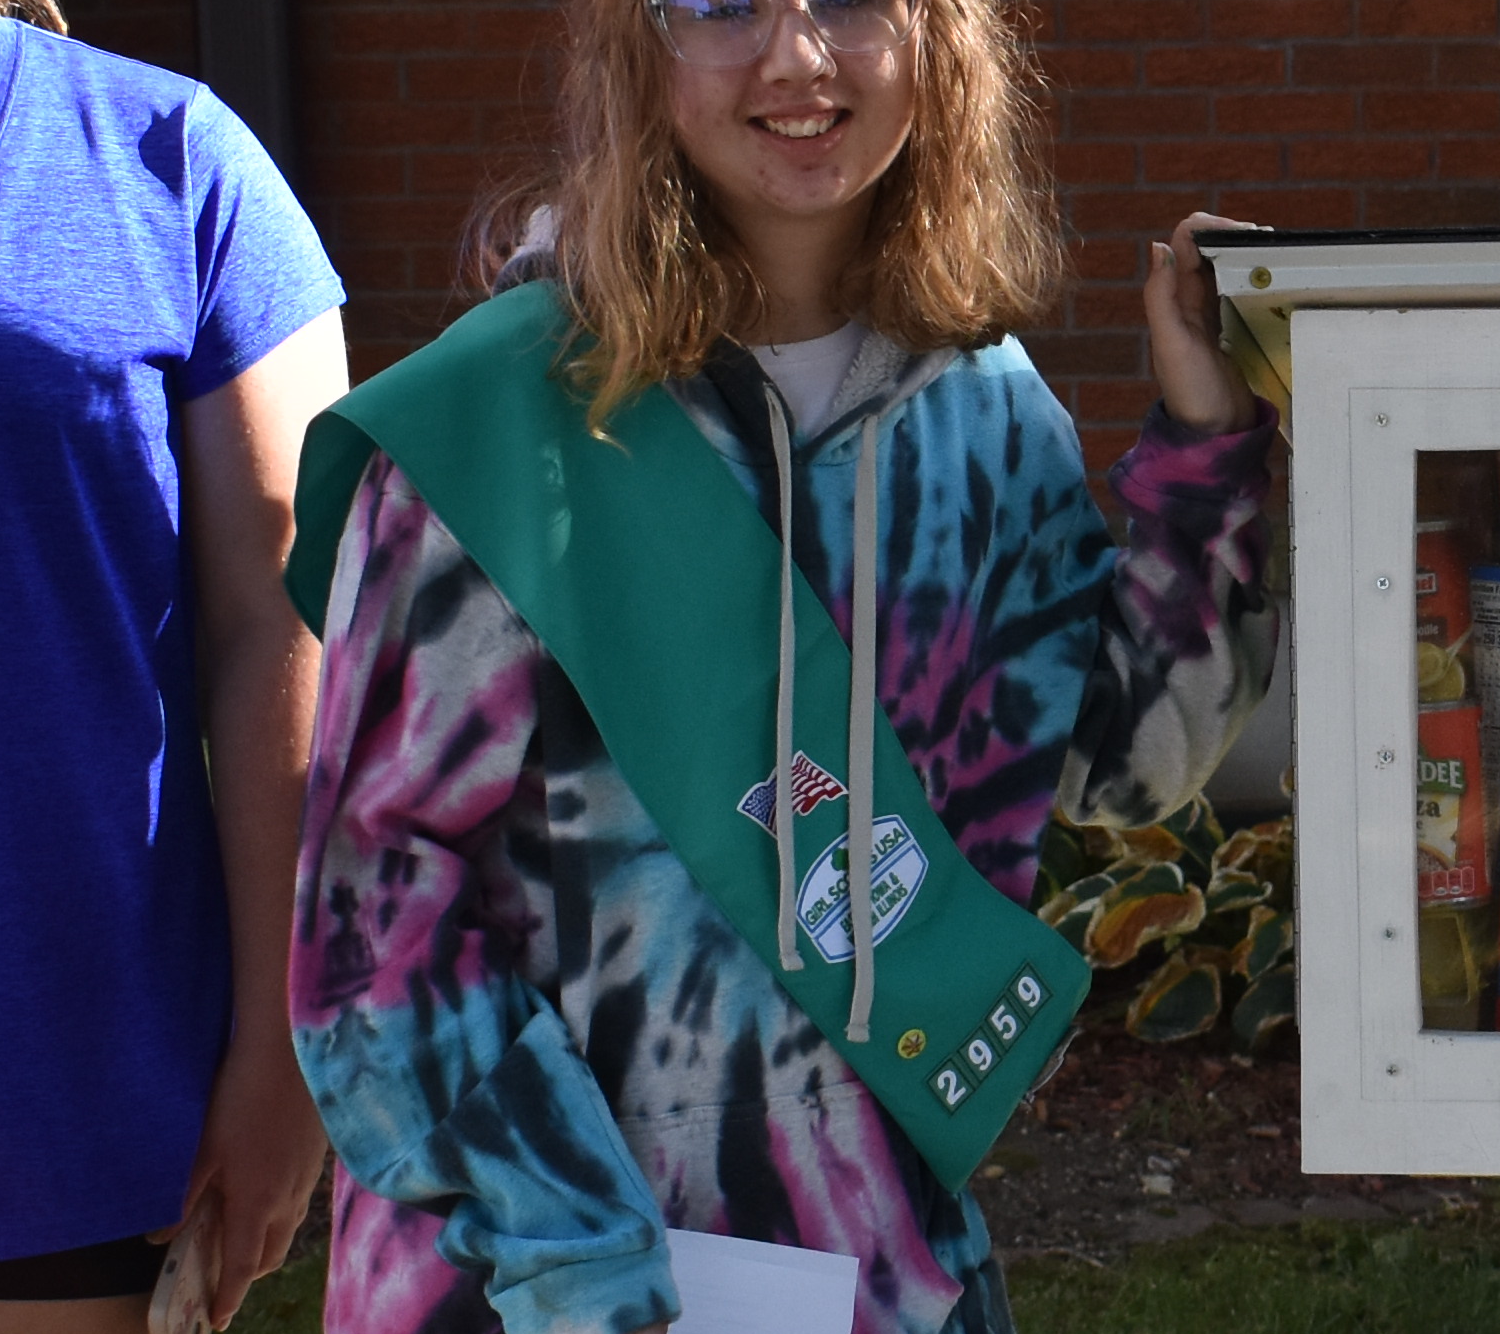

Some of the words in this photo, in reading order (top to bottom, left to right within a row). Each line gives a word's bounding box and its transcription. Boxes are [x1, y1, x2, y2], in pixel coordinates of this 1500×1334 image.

[805, 897, 833, 926] GIRL
[874, 827, 906, 856] USA
[936, 973, 1043, 1106] 2959
